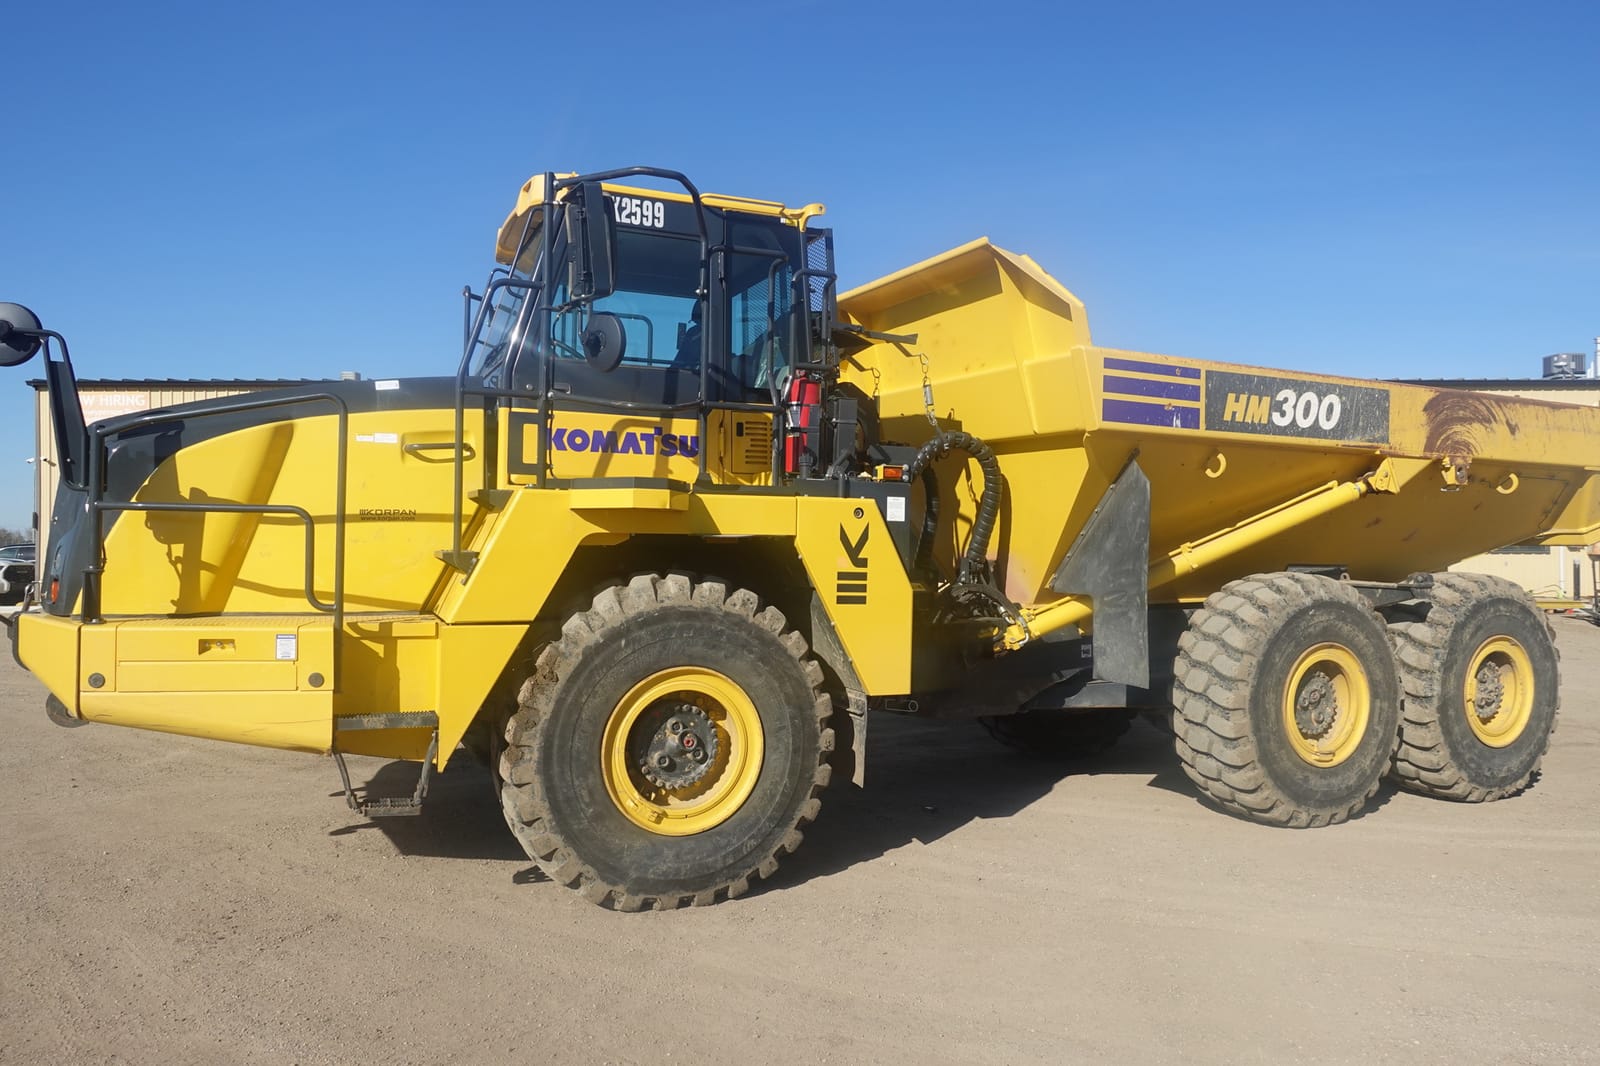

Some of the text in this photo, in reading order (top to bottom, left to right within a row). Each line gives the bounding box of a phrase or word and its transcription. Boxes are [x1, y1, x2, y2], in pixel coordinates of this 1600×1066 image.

[100, 394, 145, 406] HIRING
[1223, 388, 1342, 431] HM300
[546, 426, 699, 458] KOMATSU
